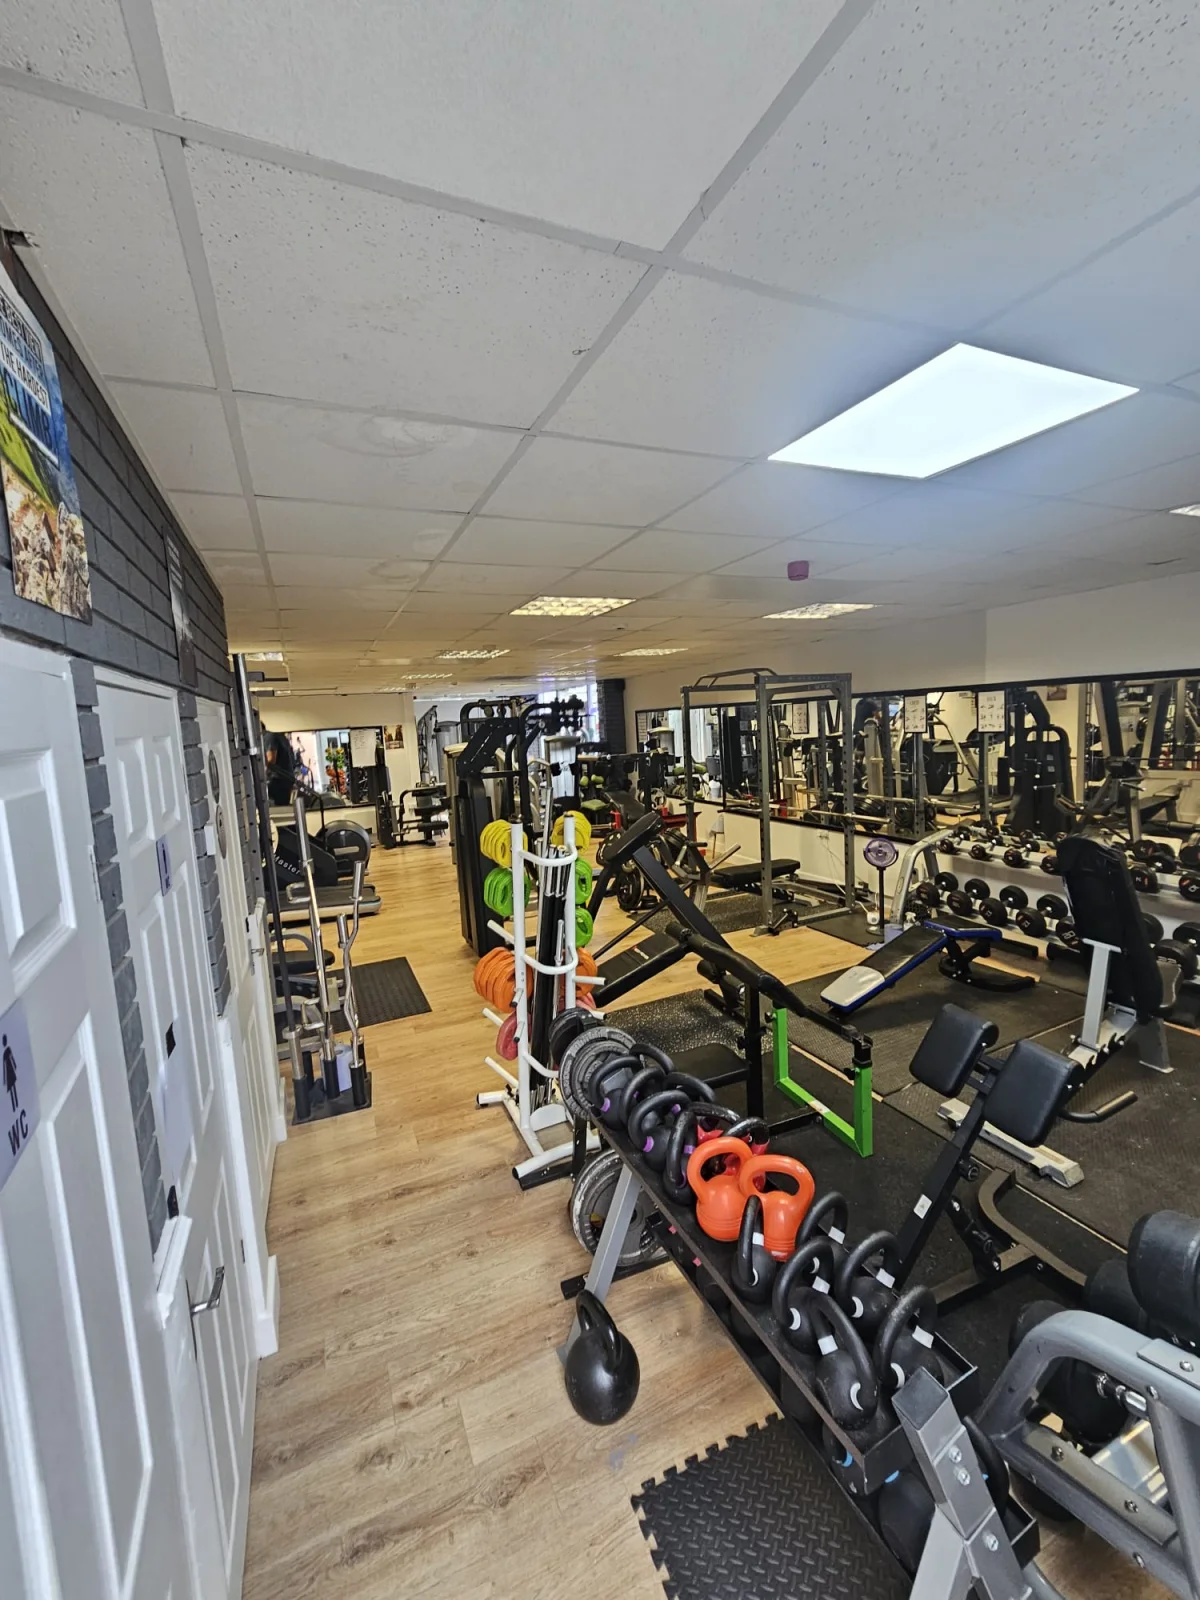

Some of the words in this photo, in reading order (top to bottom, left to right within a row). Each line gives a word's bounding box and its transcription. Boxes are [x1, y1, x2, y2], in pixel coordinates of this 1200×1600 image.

[0, 340, 16, 373] THE
[16, 357, 49, 411] HARDEST
[4, 365, 53, 452] CLIMB
[8, 1109, 28, 1156] WC
